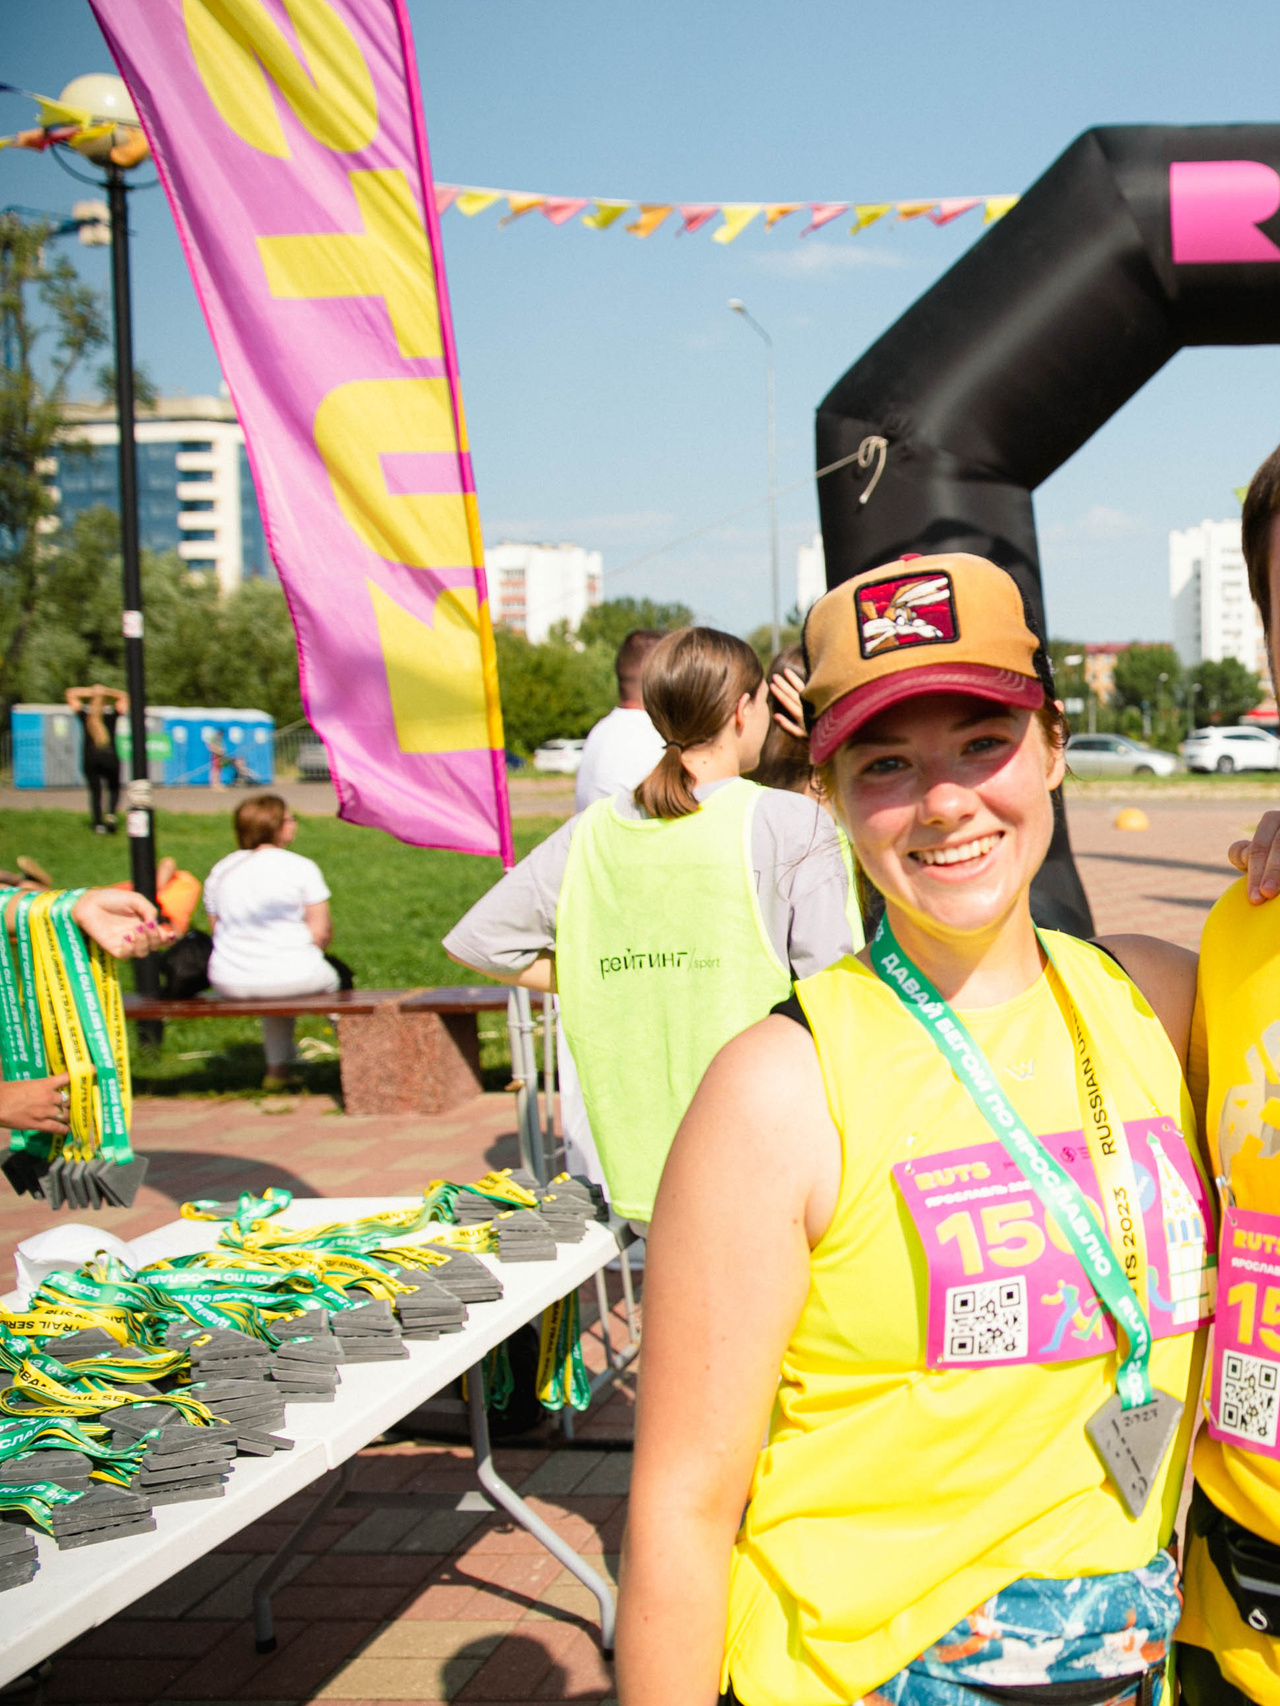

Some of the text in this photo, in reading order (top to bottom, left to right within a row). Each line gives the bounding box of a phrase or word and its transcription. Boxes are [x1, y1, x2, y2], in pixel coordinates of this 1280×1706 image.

[183, 0, 504, 754] RUTS
[881, 952, 945, 1020] ДАВАЙ
[934, 1017, 993, 1092] БЕГОМ
[1008, 1128, 1112, 1277] ЯРОСЛАВЛЮ
[1082, 1057, 1117, 1157] RUSSIAN
[914, 1161, 991, 1191] RUTS
[1113, 1187, 1136, 1247] 2023
[68, 1281, 100, 1298] 2023
[1117, 1295, 1148, 1360] RUTS
